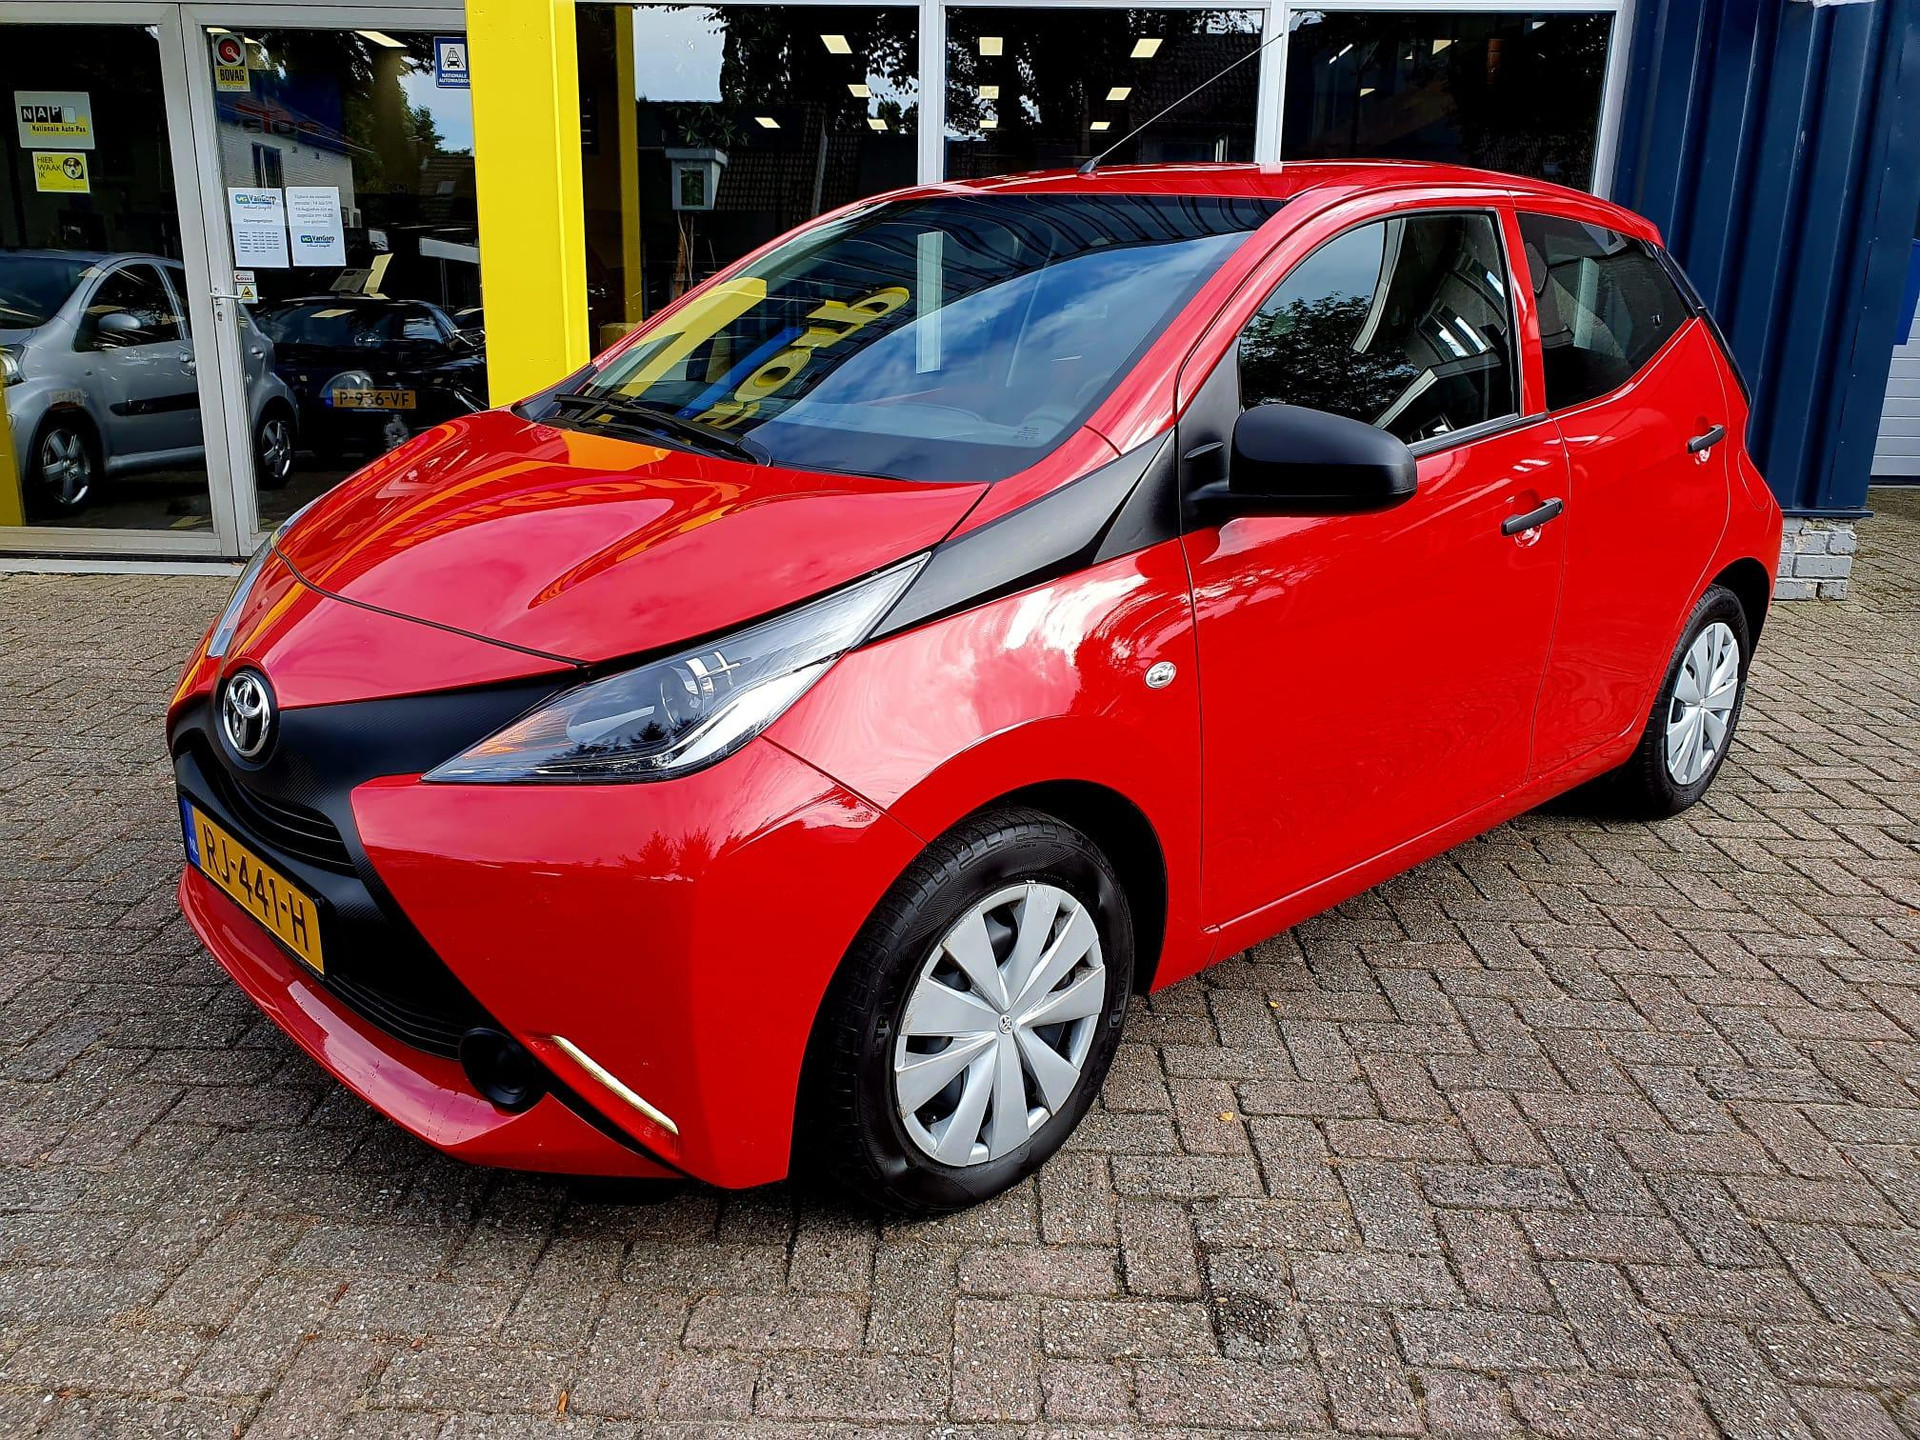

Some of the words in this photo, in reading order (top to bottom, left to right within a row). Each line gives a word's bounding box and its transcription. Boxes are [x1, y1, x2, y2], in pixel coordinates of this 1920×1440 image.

[220, 69, 245, 81] BOVAG
[22, 106, 60, 120] NAP
[339, 392, 410, 406] P-936-VF
[202, 822, 310, 952] RJ-441-H
